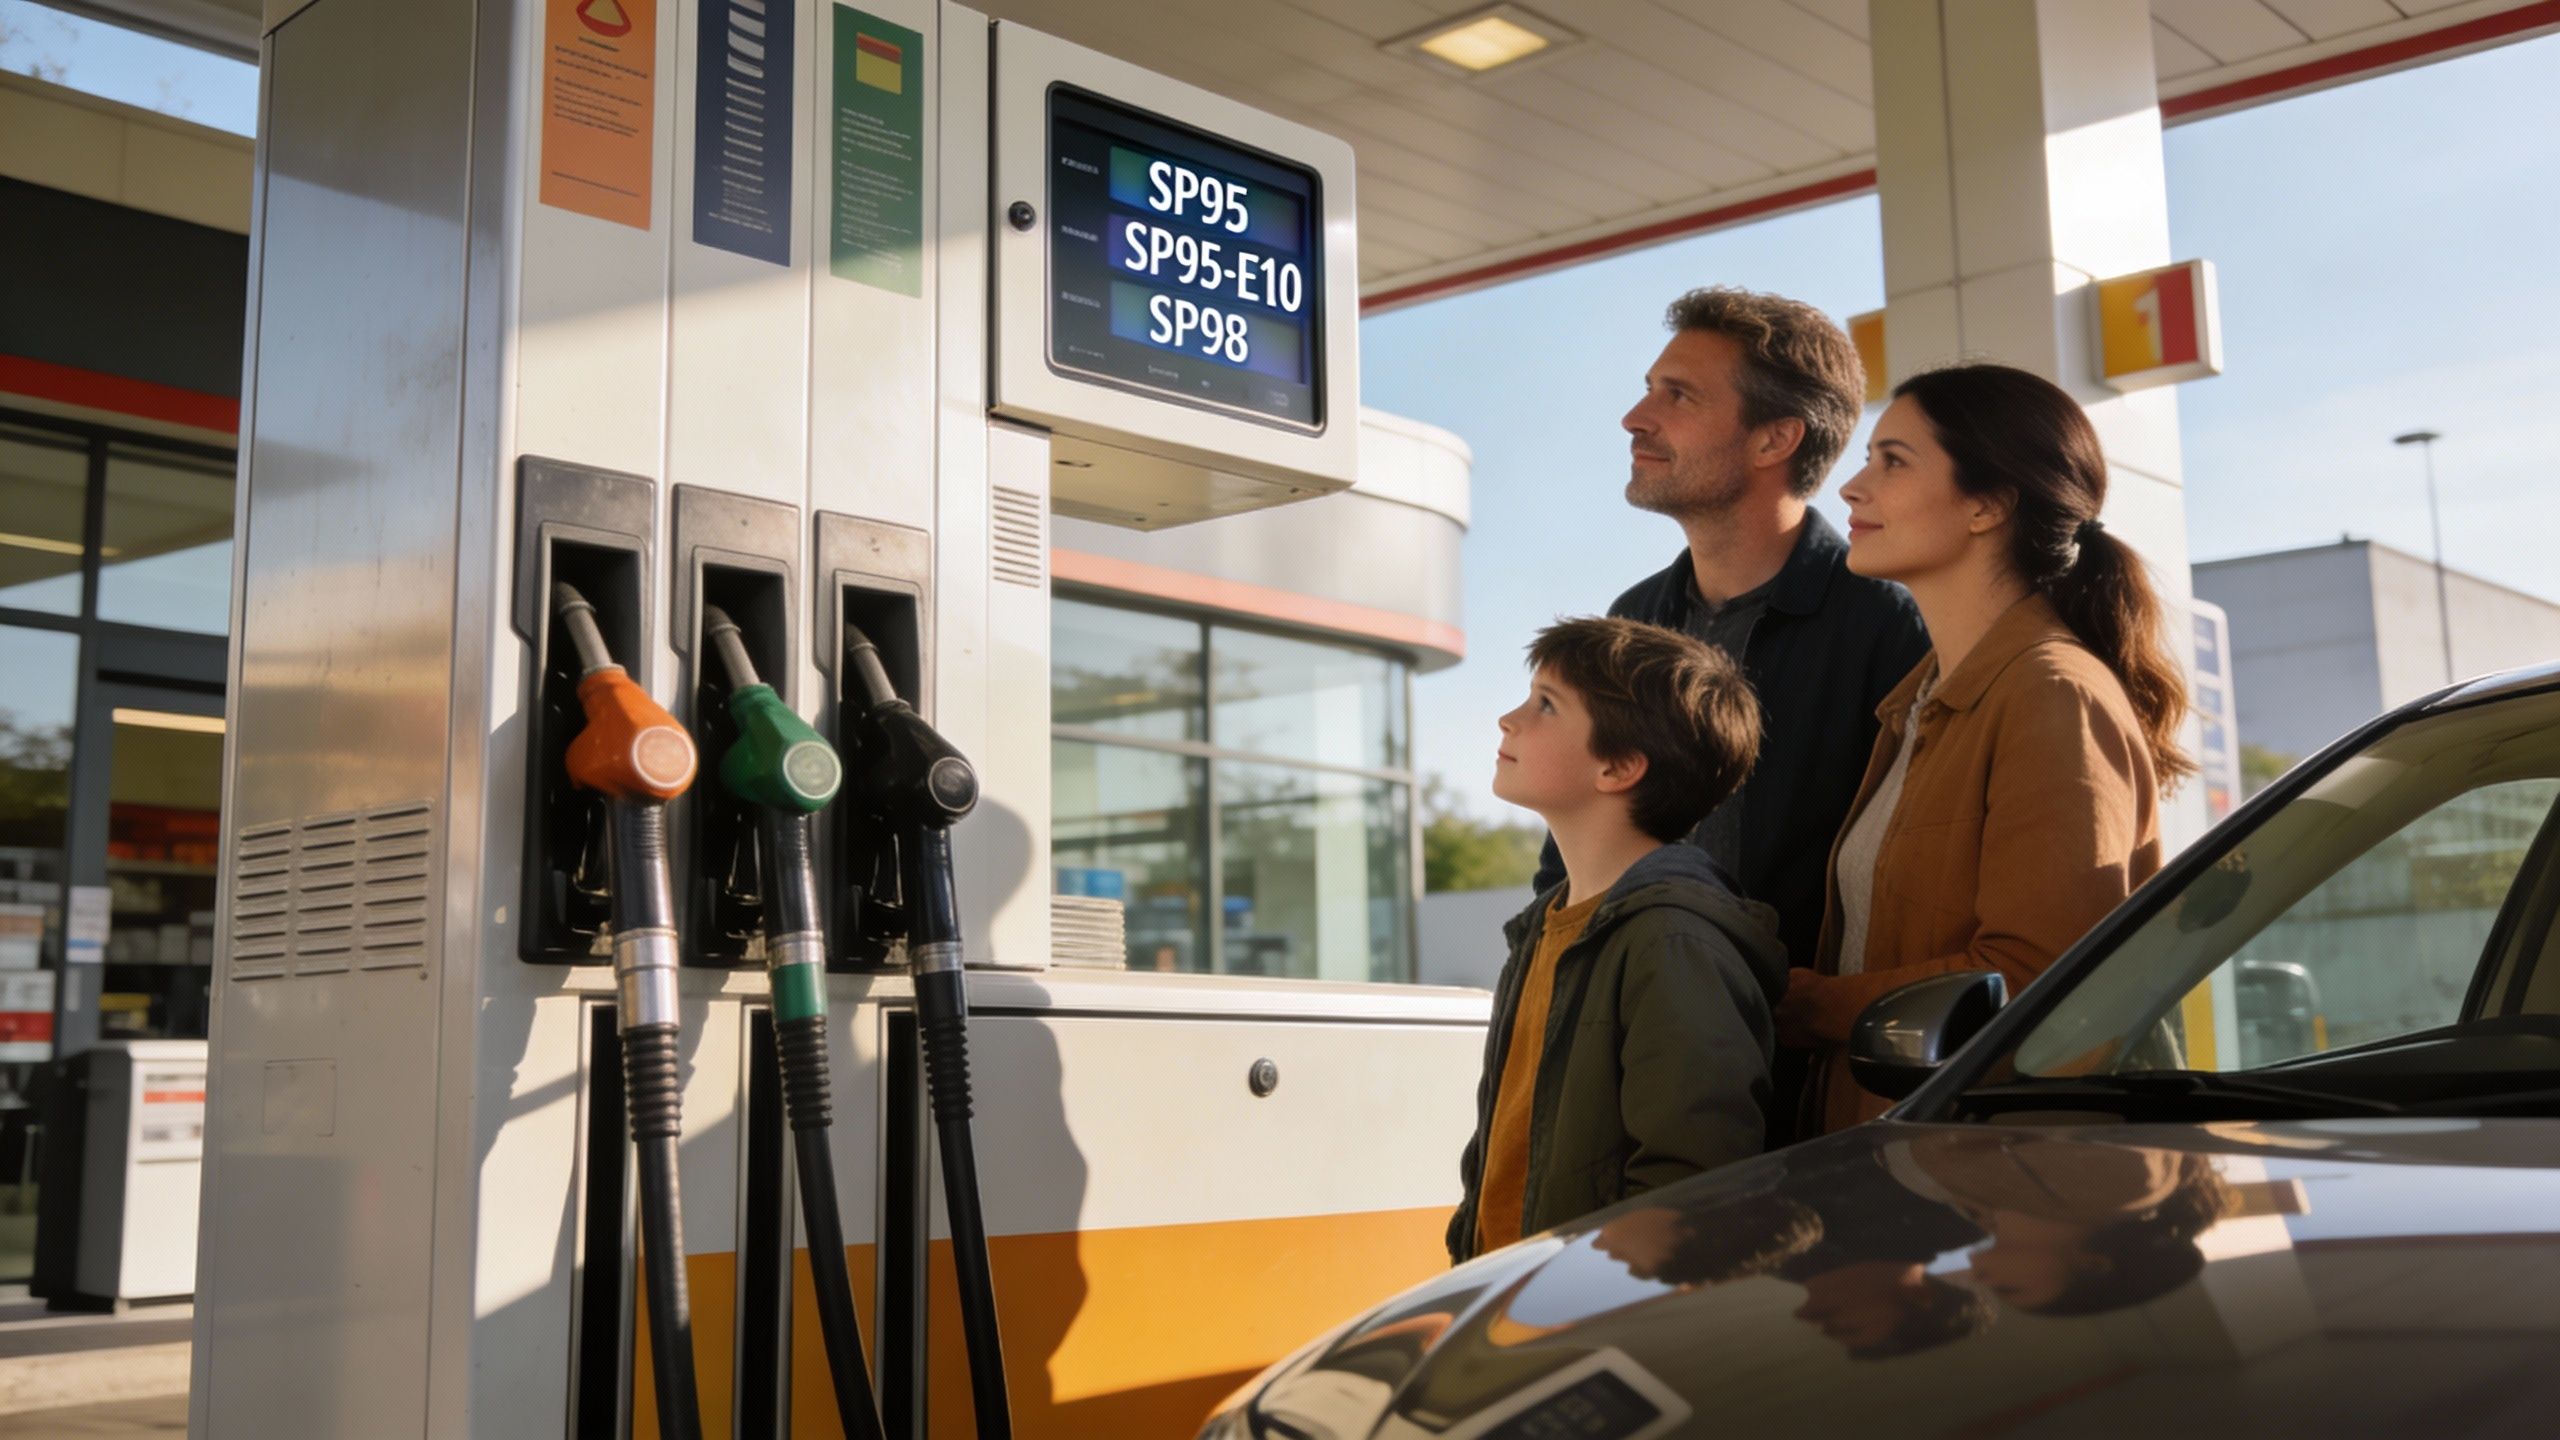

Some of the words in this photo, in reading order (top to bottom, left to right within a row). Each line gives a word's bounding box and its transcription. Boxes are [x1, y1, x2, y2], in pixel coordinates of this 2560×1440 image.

[1148, 161, 1248, 233] SP95
[1125, 221, 1302, 312] SP95-E10
[1149, 294, 1249, 363] SP98
[2133, 287, 2163, 363] 1
